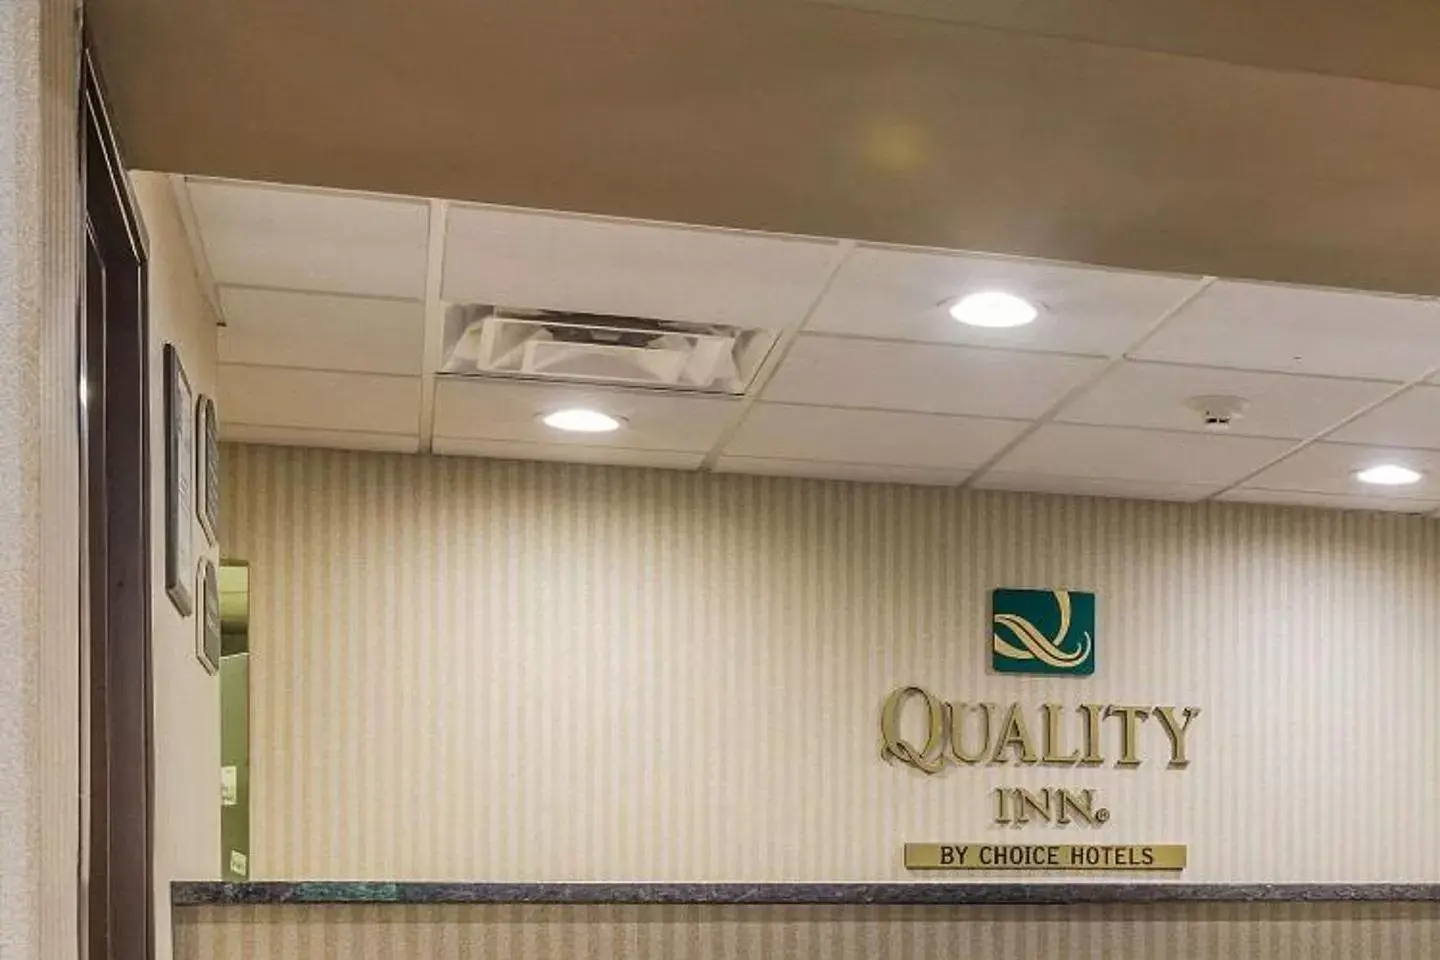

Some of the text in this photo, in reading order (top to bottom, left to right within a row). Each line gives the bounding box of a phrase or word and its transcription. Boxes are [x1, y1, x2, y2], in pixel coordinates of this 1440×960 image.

[880, 686, 1200, 774] QUALITY
[940, 846, 1155, 866] BY CHOICE HOTELS
